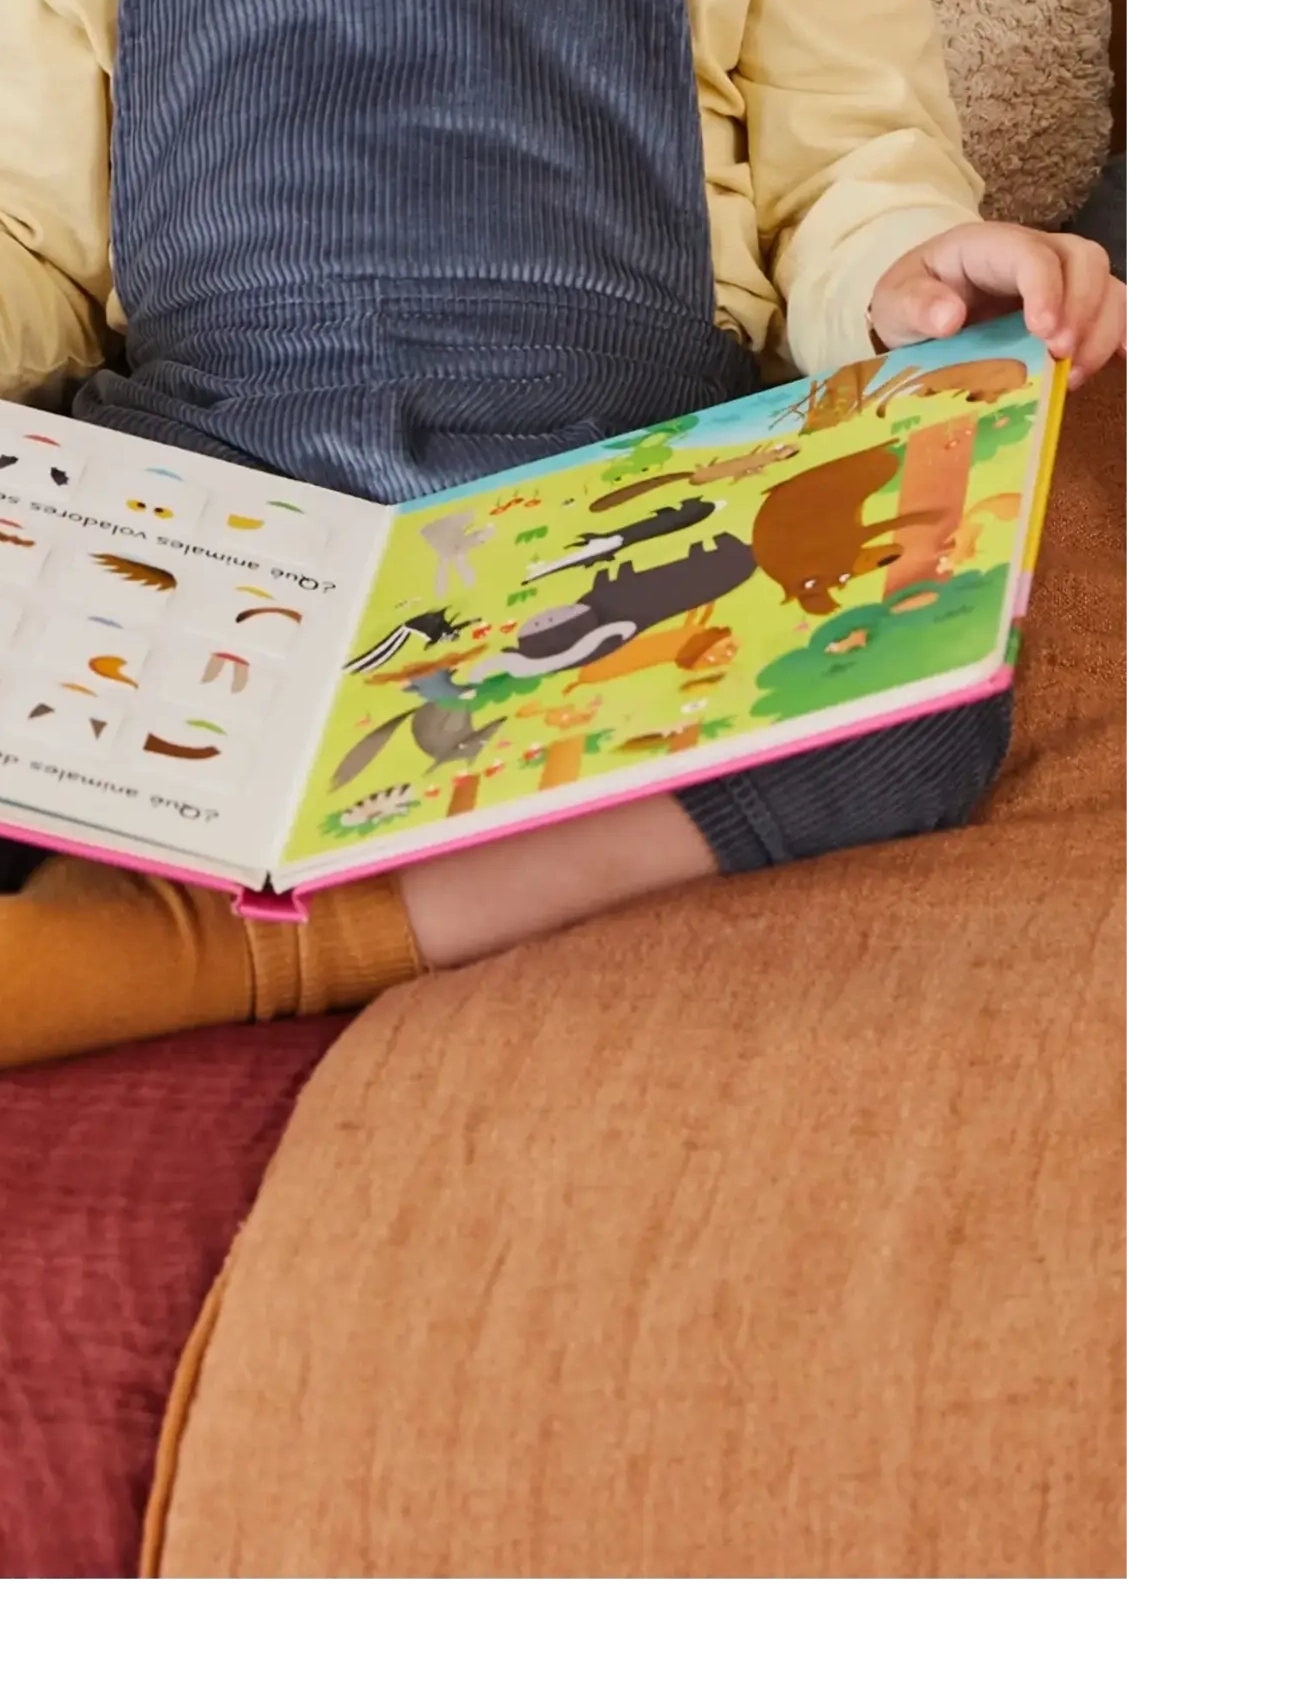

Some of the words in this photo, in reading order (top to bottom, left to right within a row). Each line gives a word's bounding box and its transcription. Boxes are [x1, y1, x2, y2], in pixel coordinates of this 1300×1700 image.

[29, 500, 147, 540] voladores
[157, 535, 260, 571] animales
[270, 566, 337, 593] ¿Qué
[29, 763, 139, 797] animales
[149, 795, 220, 823] ¿Qué
